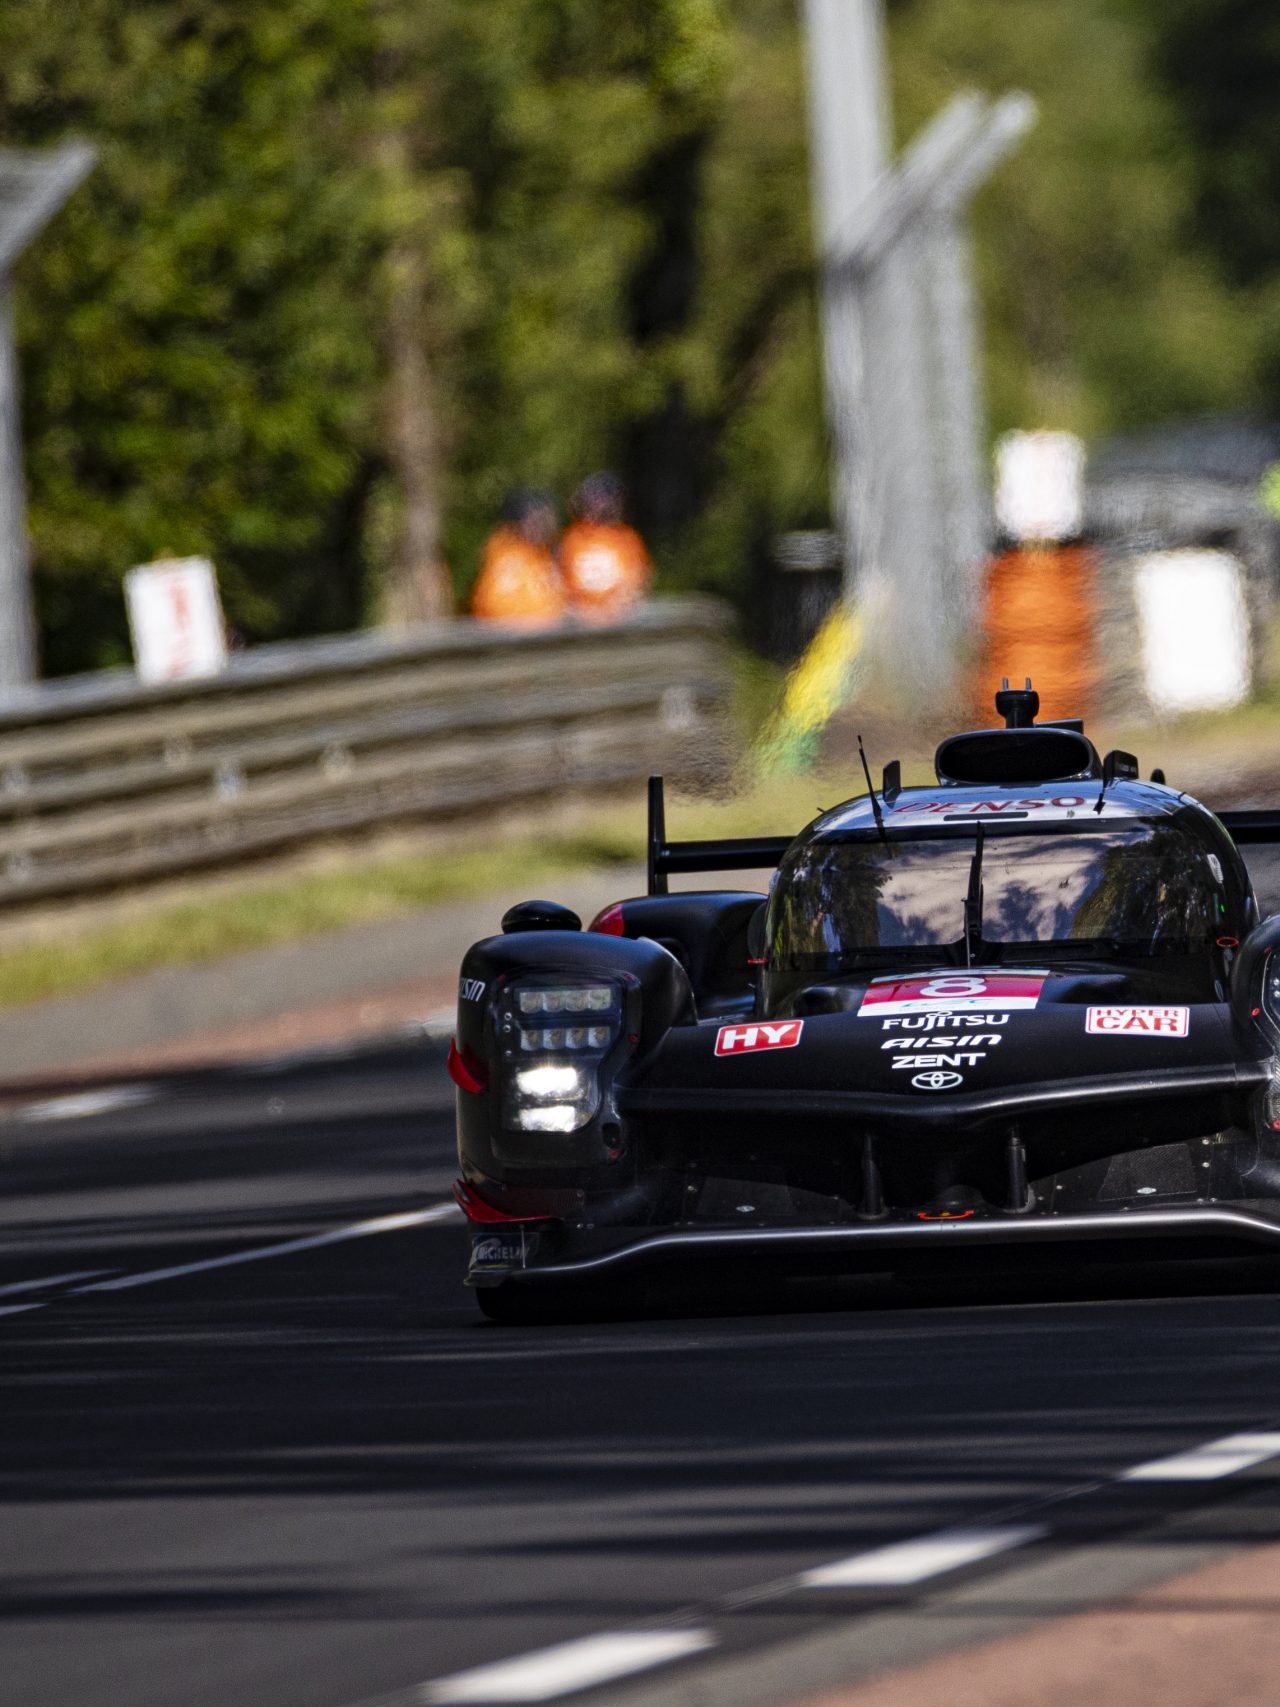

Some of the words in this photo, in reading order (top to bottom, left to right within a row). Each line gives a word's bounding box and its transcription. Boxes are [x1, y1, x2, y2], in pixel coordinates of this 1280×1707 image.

[893, 796, 1086, 813] DENSO
[919, 976, 988, 998] 8
[881, 1012, 1010, 1031] FUJITSU
[1096, 1009, 1178, 1017] HYPER
[1096, 1016, 1178, 1031] CAR
[722, 1023, 797, 1050] HY
[880, 1033, 1002, 1049] AISIN
[891, 1052, 987, 1069] ZENT
